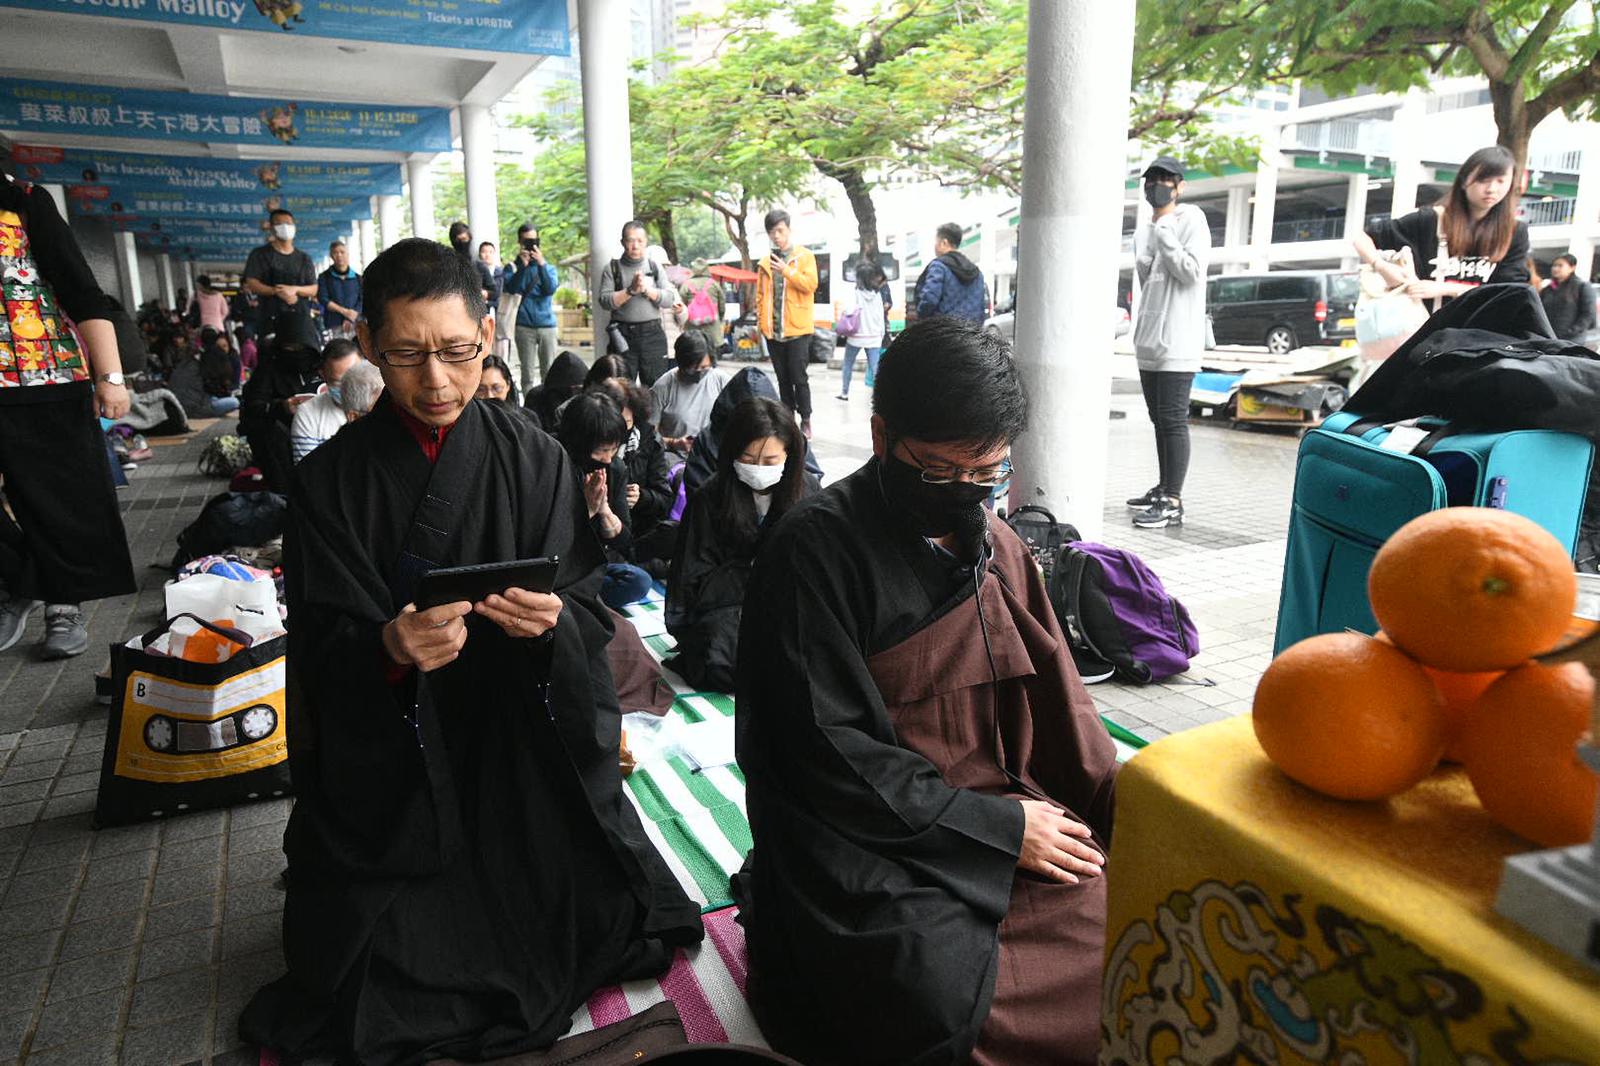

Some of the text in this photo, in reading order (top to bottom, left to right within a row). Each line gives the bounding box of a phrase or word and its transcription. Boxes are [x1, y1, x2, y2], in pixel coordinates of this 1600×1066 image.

[427, 12, 462, 25] Tickets
[464, 17, 474, 26] at
[137, 682, 146, 698] B
